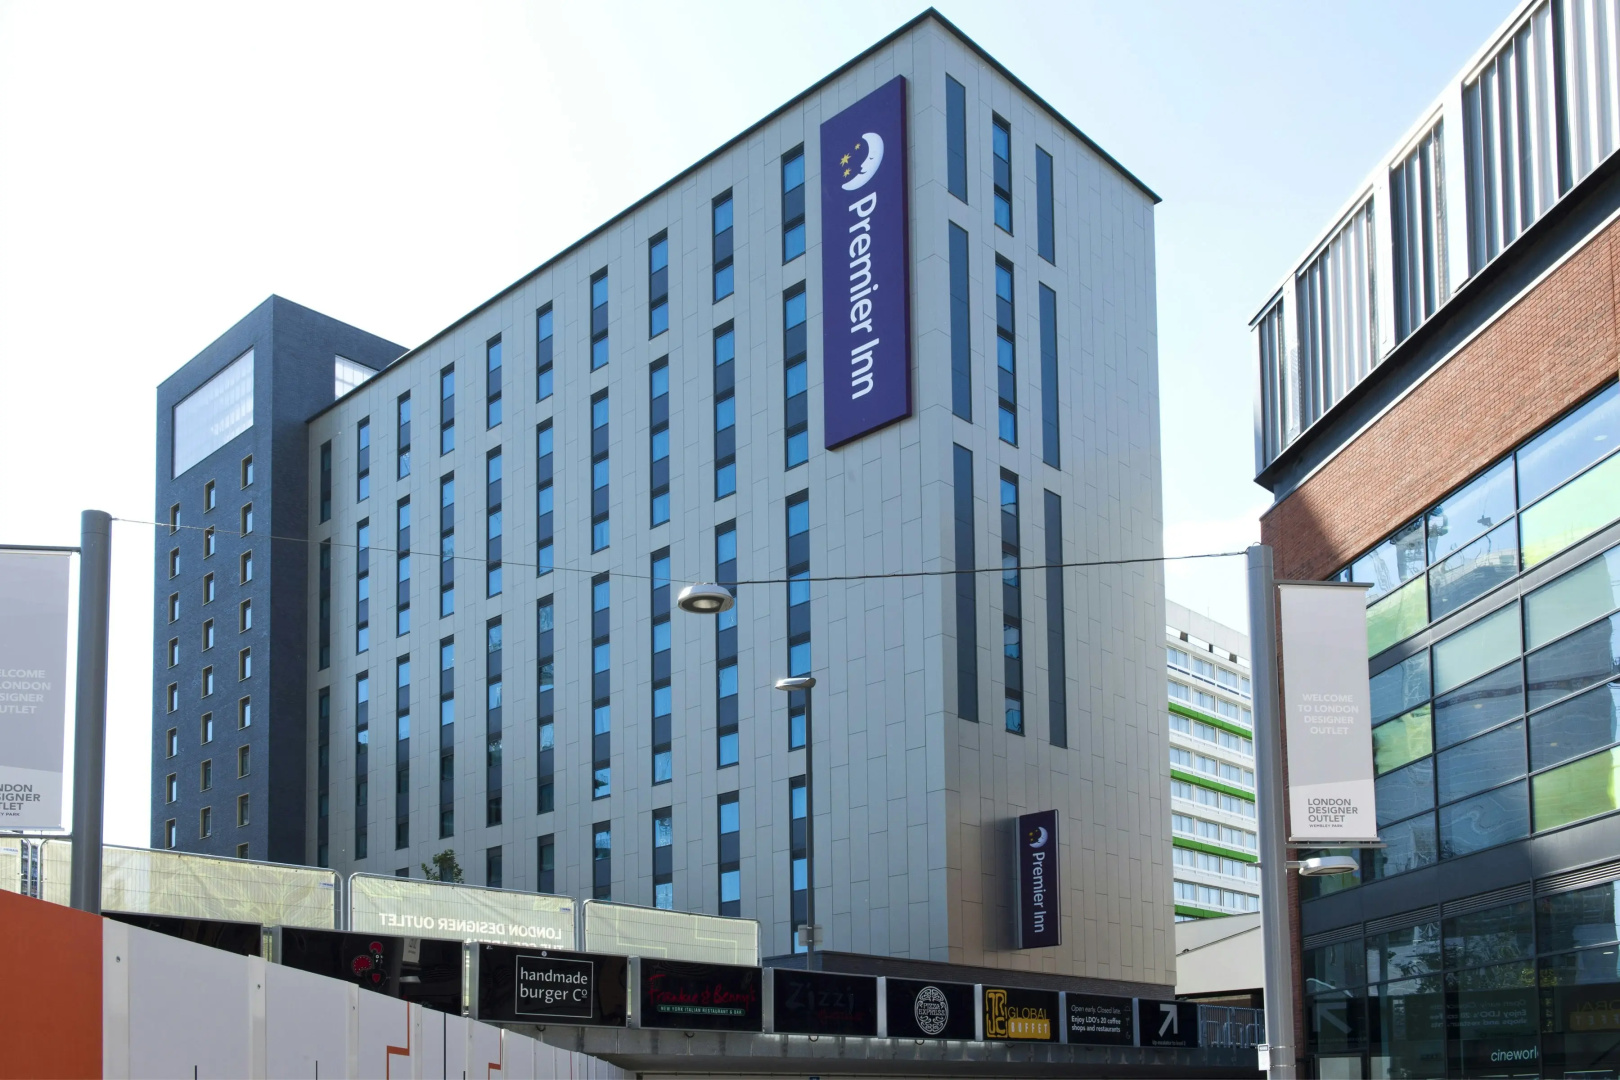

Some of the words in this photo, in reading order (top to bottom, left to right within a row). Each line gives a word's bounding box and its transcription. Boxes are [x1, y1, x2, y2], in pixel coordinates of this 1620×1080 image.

[848, 191, 878, 334] Premier
[851, 337, 880, 400] Inn
[0, 669, 46, 679] LCOME
[0, 680, 51, 691] ONDON
[1302, 693, 1354, 703] WELCOME
[1297, 704, 1312, 713] TO
[1314, 704, 1359, 714] LONDON
[1303, 715, 1354, 724] DESIGNER
[1310, 726, 1349, 735] OUTLET
[0, 793, 41, 802] IGNER
[1307, 798, 1351, 806] LONDON
[1308, 806, 1358, 814] DESIGNER
[1032, 851, 1046, 908] Premier
[1034, 910, 1047, 933] Inn
[520, 966, 588, 984] handmade
[520, 983, 569, 1004] burger
[1008, 1006, 1047, 1019] GLOBAL
[1071, 1004, 1085, 1013] Open
[1097, 1006, 1112, 1014] Closed
[1071, 1016, 1085, 1025] Enjoy
[1086, 1016, 1100, 1024] LDO's
[1010, 1021, 1048, 1035] BUFFET
[1071, 1024, 1086, 1032] shops
[1490, 1045, 1539, 1062] cineworl
